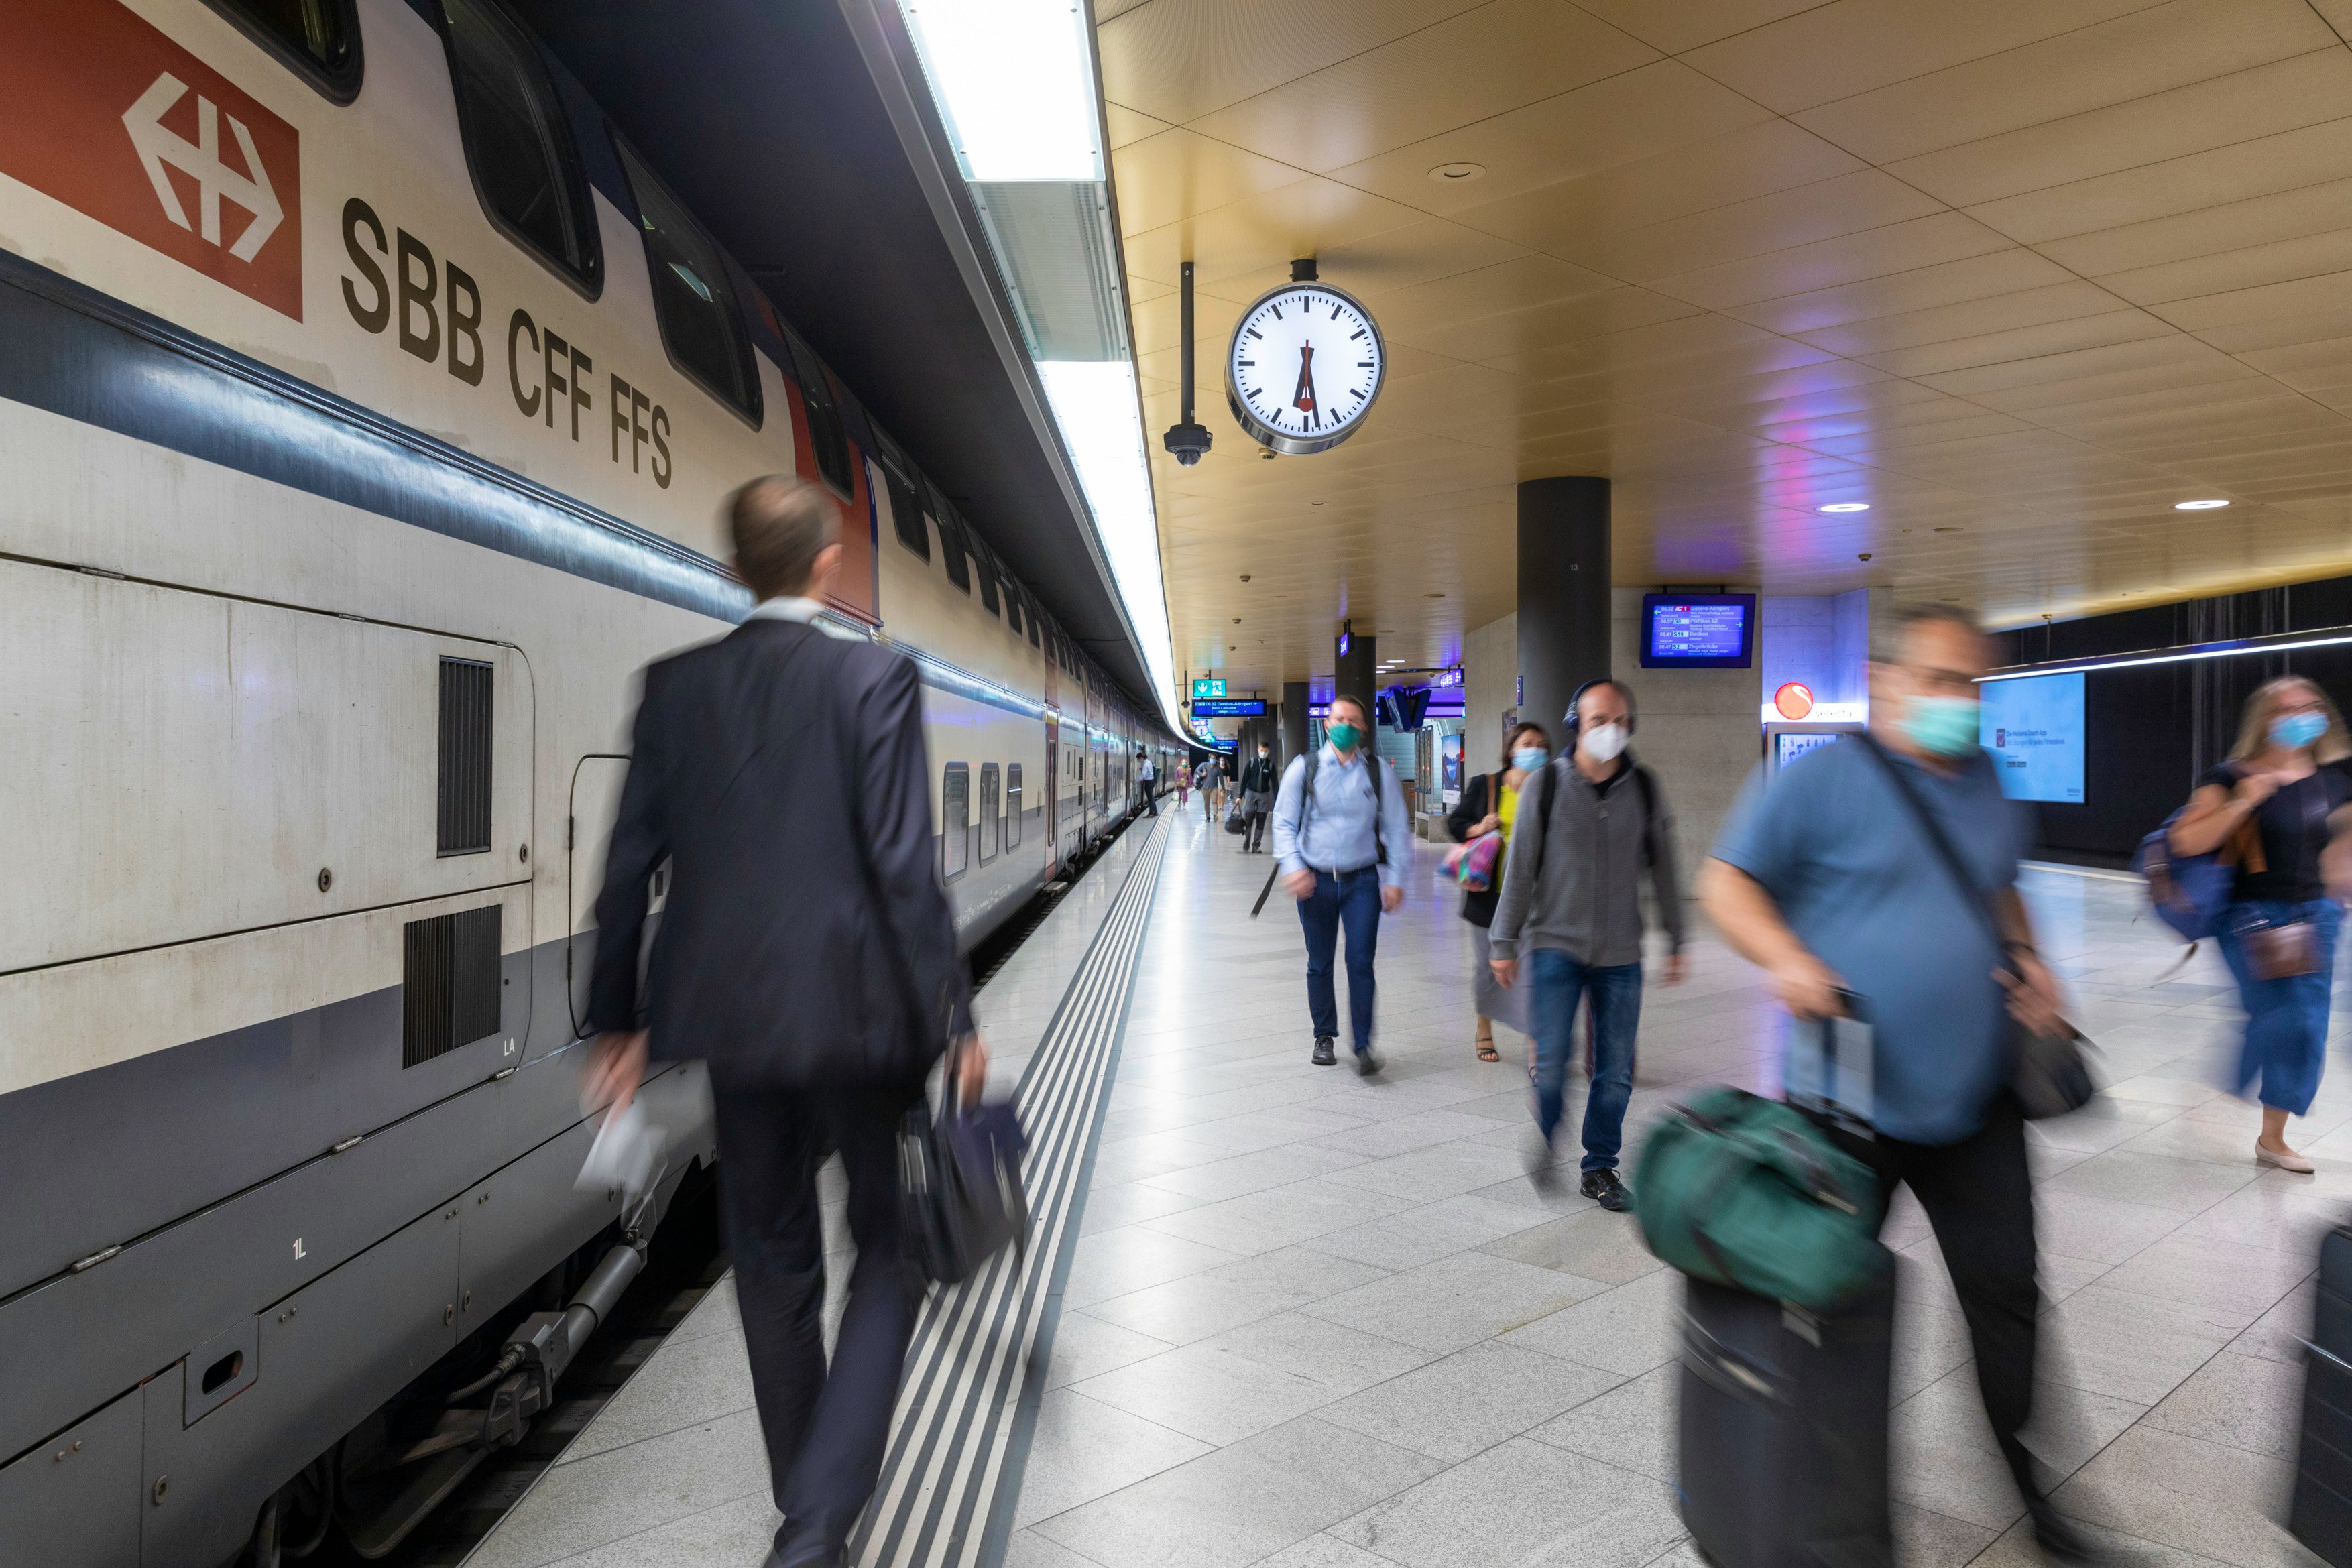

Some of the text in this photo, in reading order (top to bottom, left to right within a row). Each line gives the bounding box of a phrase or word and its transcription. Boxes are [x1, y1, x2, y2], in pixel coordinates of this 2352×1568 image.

[341, 198, 672, 489] SBB CFF FFS
[504, 1037, 515, 1057] LA
[292, 1237, 306, 1260] 1L
